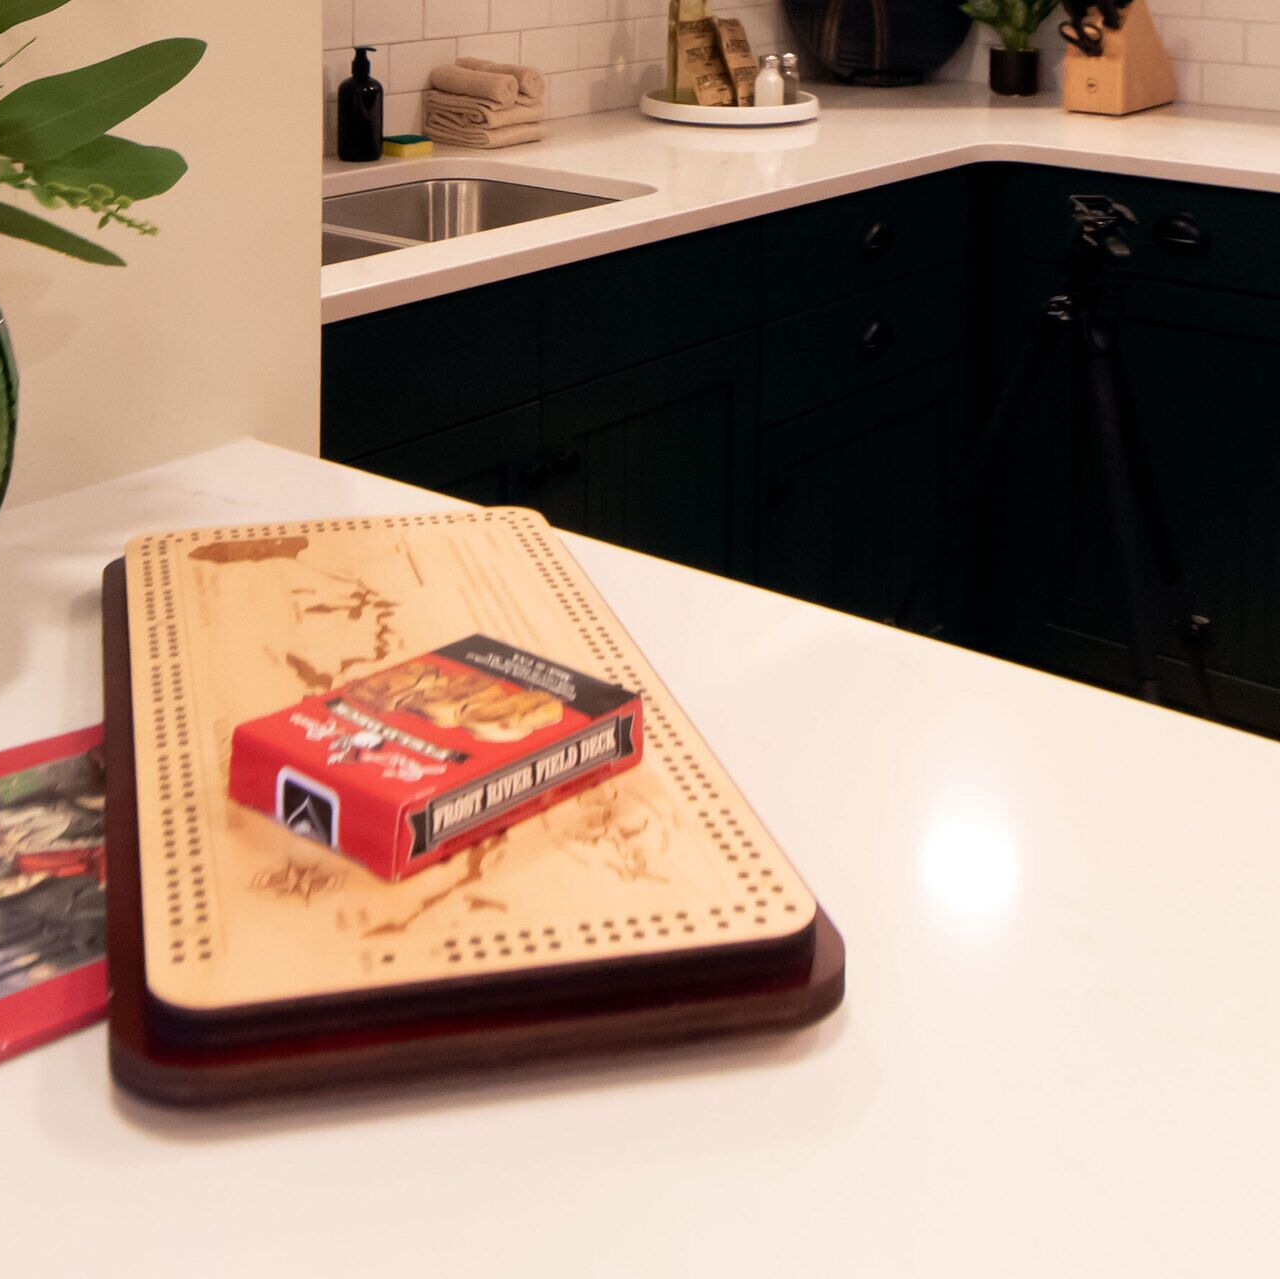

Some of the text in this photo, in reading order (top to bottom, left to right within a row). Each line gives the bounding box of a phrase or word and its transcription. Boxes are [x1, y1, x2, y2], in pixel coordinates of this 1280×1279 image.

[487, 766, 534, 809] RIVER
[536, 744, 579, 785] FIELD
[580, 726, 617, 763] DECK
